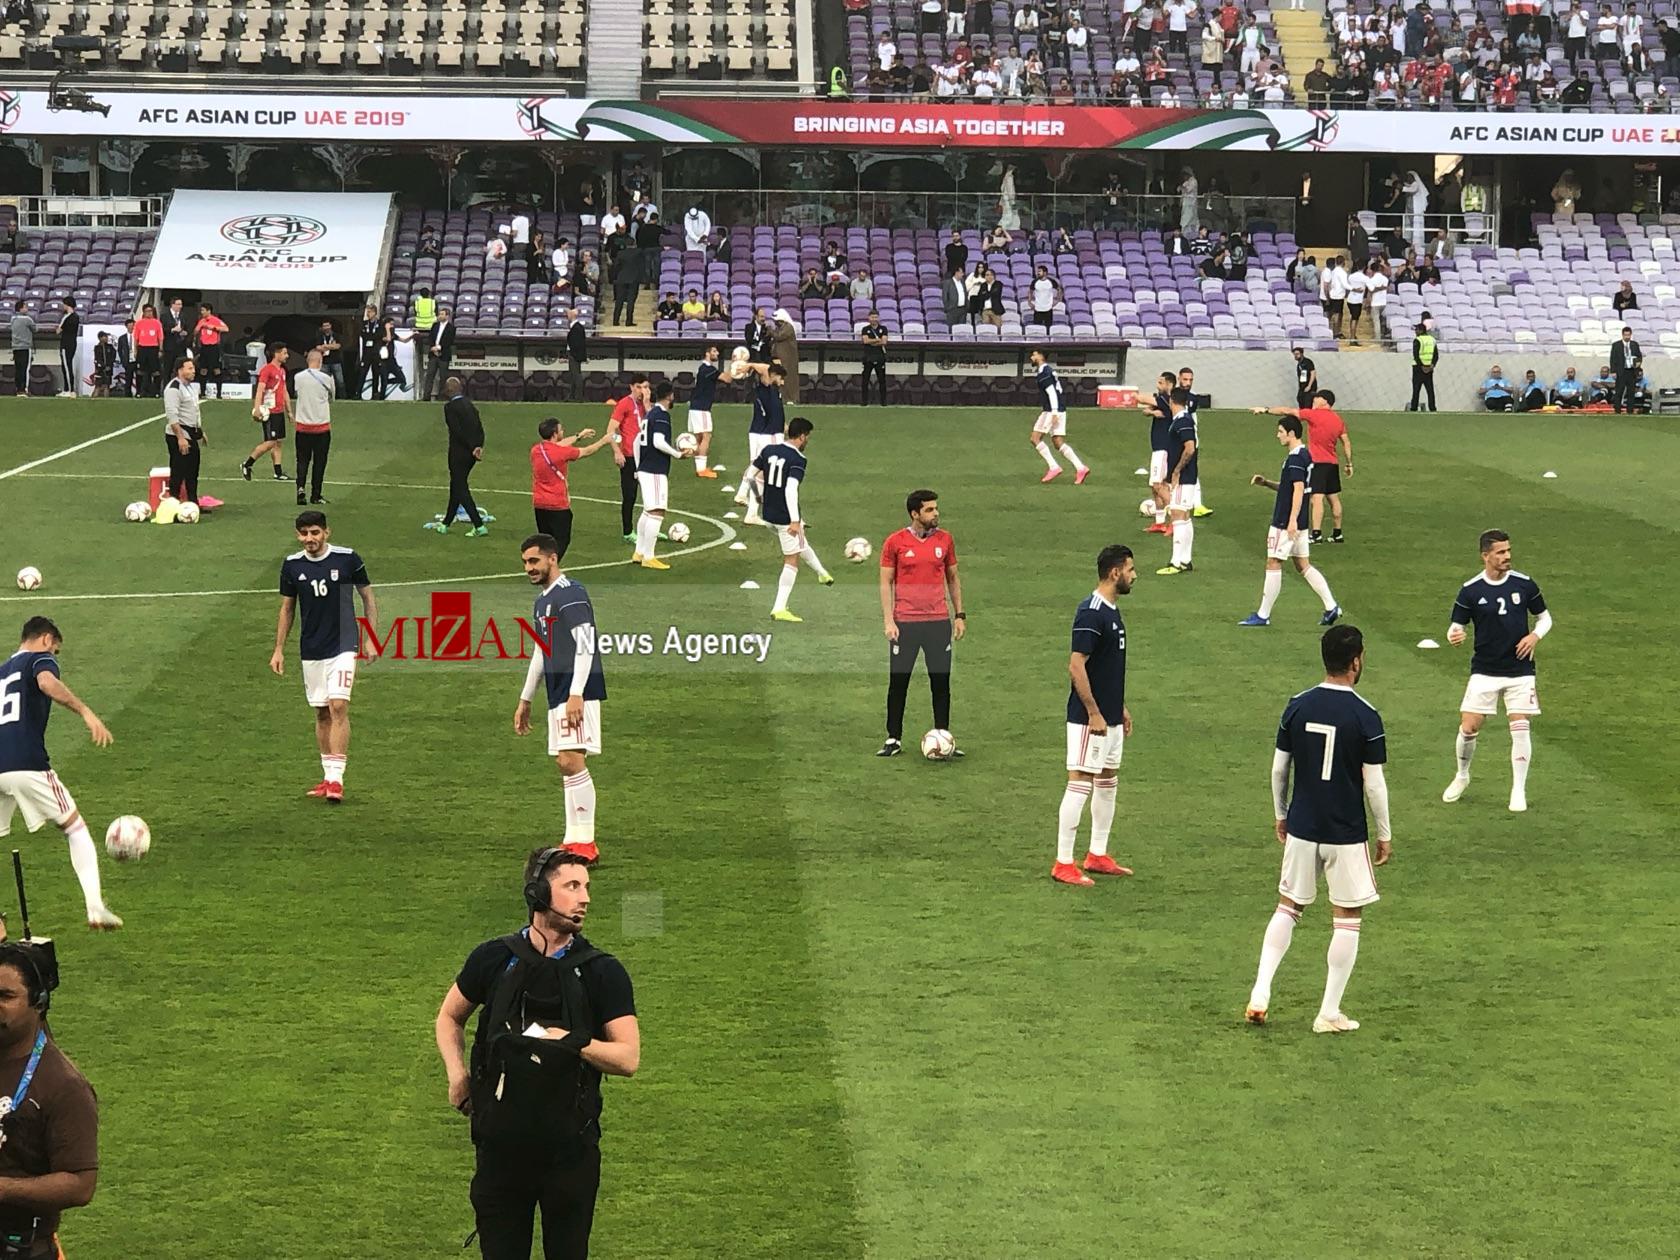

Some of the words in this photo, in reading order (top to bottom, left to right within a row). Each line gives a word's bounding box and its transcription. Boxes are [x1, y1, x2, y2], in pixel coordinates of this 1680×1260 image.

[138, 108, 178, 124] AFC
[185, 109, 249, 124] ASIAN
[254, 110, 297, 125] CUP
[304, 110, 347, 125] UAE
[794, 116, 896, 133] BRINGING
[900, 118, 949, 135] ASIA
[953, 119, 1065, 136] TOGETHER
[1450, 126, 1489, 141] AFC
[1496, 126, 1557, 142] ASIAN
[1562, 127, 1604, 142] CUP
[1611, 128, 1654, 143] UAE
[185, 253, 278, 263] ASIAN
[287, 255, 348, 263] CUP
[767, 454, 786, 488] 11
[310, 578, 328, 597] 16
[1496, 597, 1508, 615] 2
[338, 670, 353, 688] 16
[1304, 721, 1337, 781] 7
